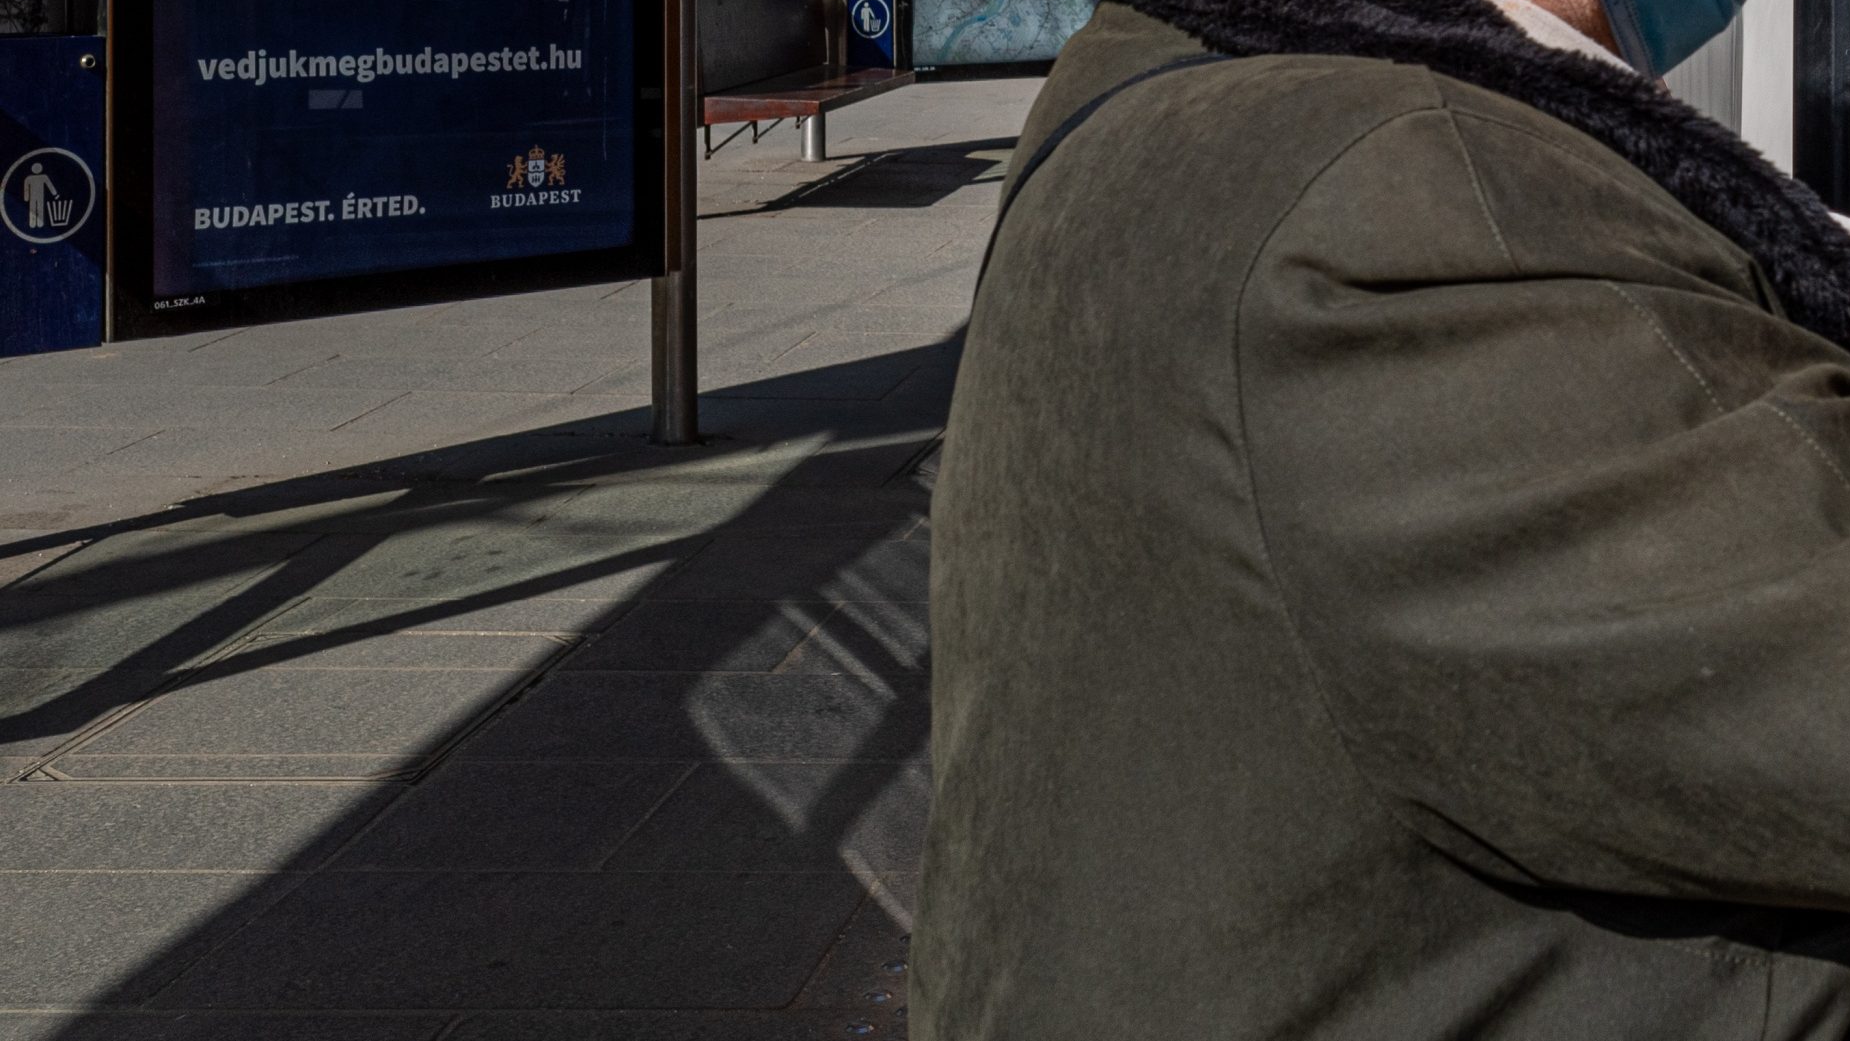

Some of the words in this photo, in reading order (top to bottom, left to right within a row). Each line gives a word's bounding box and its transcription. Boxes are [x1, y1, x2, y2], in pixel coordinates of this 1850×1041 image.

[197, 43, 583, 86] vedjukmegbudapestet.hu
[194, 199, 335, 231] BUDAPEST.
[341, 192, 427, 221] ÉRTED.
[489, 188, 583, 209] BUDAPEST
